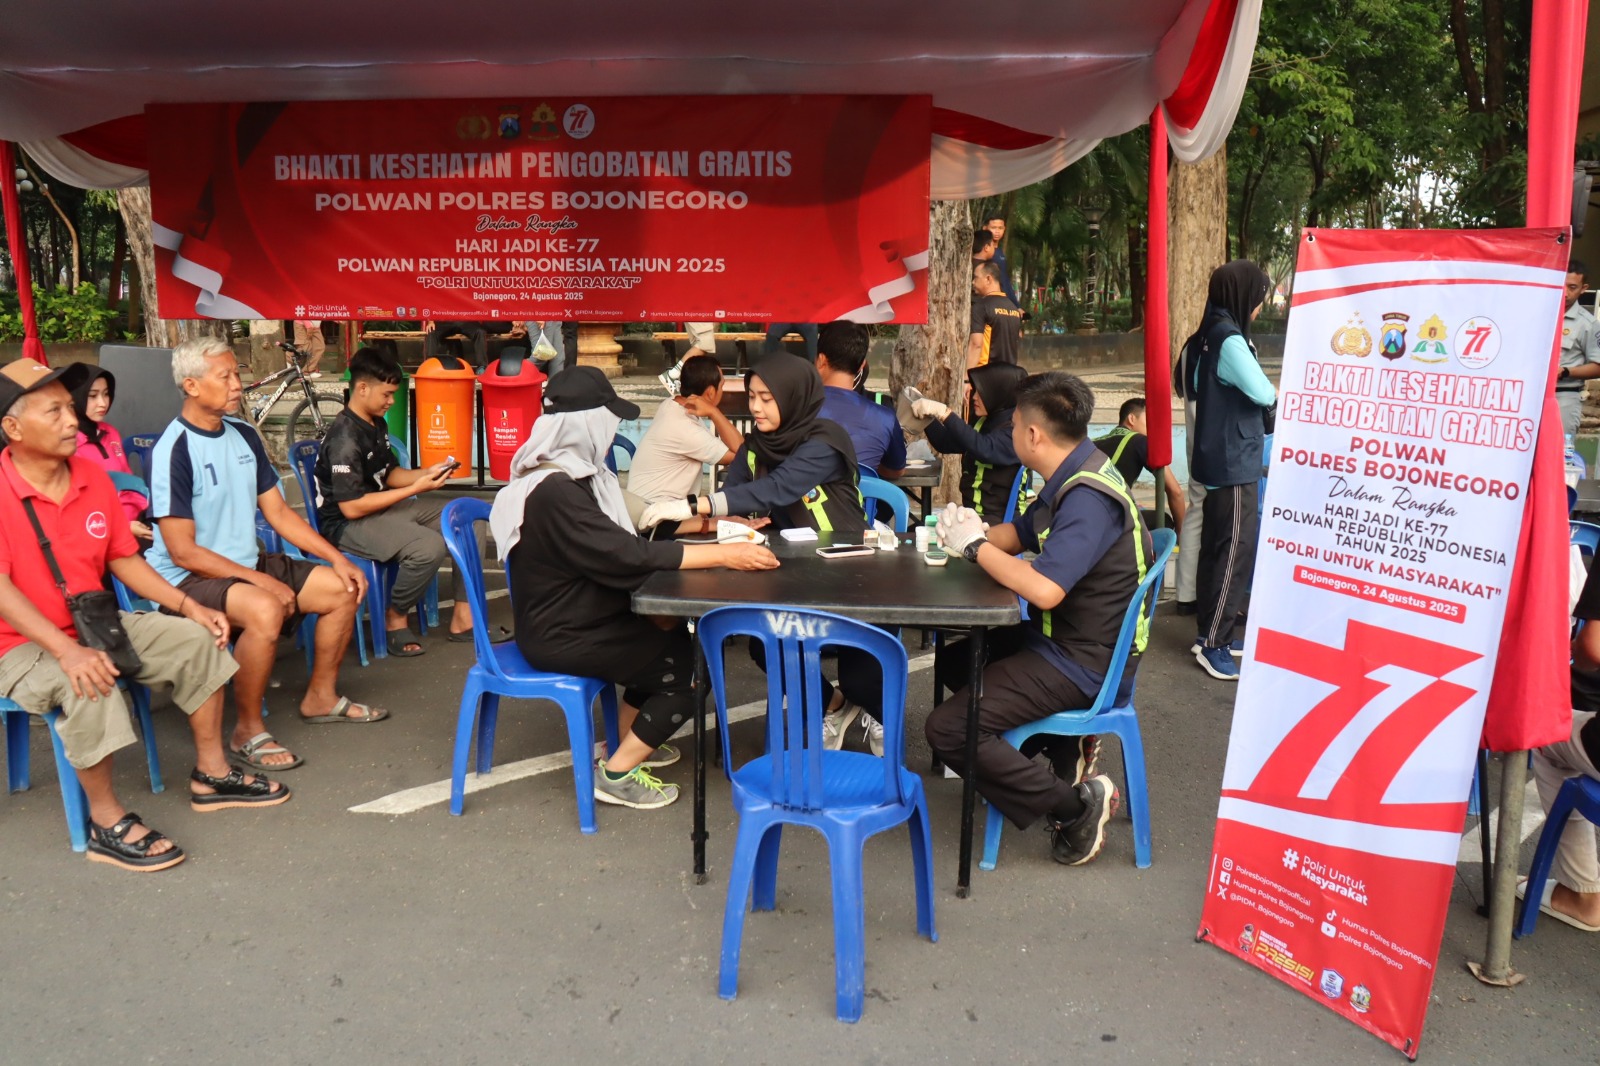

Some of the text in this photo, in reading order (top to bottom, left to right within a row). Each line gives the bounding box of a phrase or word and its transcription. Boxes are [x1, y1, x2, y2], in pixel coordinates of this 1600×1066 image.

[274, 150, 792, 181] BHAKTI KESEHATAN PENGOBATAN GRATIS
[315, 190, 749, 212] POLWAN POLRES BOJONEGORO
[475, 214, 578, 234] Dalam Rangka
[455, 238, 600, 253] HARI JADI KE-77
[337, 258, 726, 273] POLWAN REPUBLIK INDONESIA TAHUN 2025
[469, 276, 525, 289] UNTUK
[472, 292, 584, 301] Bojonegoro, 24 Agustus 2025
[308, 311, 350, 319] Masyarakat
[1463, 326, 1493, 356] 77
[1304, 361, 1524, 413] BAKTI KESEHATAN
[493, 426, 518, 434] Sampah
[1282, 392, 1534, 452] PENGOBATAN GRATIS
[1350, 436, 1447, 466] POLWAN
[1280, 447, 1520, 501] POLRES BOJONEGORO
[1328, 475, 1459, 518] Dalam Rangka
[1272, 507, 1507, 567] POLWAN REPUBLIK INDONESIA
[1324, 503, 1449, 537] HARI JADI KE-77
[1323, 550, 1374, 573] UNTUK
[1335, 534, 1427, 565] TAHUN 2025
[1300, 569, 1459, 617] Bojonegoro, 24 Agustus 2025
[1253, 618, 1486, 805] 77
[1235, 865, 1311, 906] Polresbojonegoroofficial
[1301, 865, 1369, 906] Masyarakat
[1303, 855, 1327, 876] Polri
[1329, 868, 1366, 893] Untuk
[1233, 879, 1315, 924] Humas Polres Bojonegoro
[1256, 942, 1315, 981] PRESISI
[1338, 931, 1403, 970] Polres Bojonegoro
[1342, 917, 1432, 970] Humas Polres Bojonegoro
